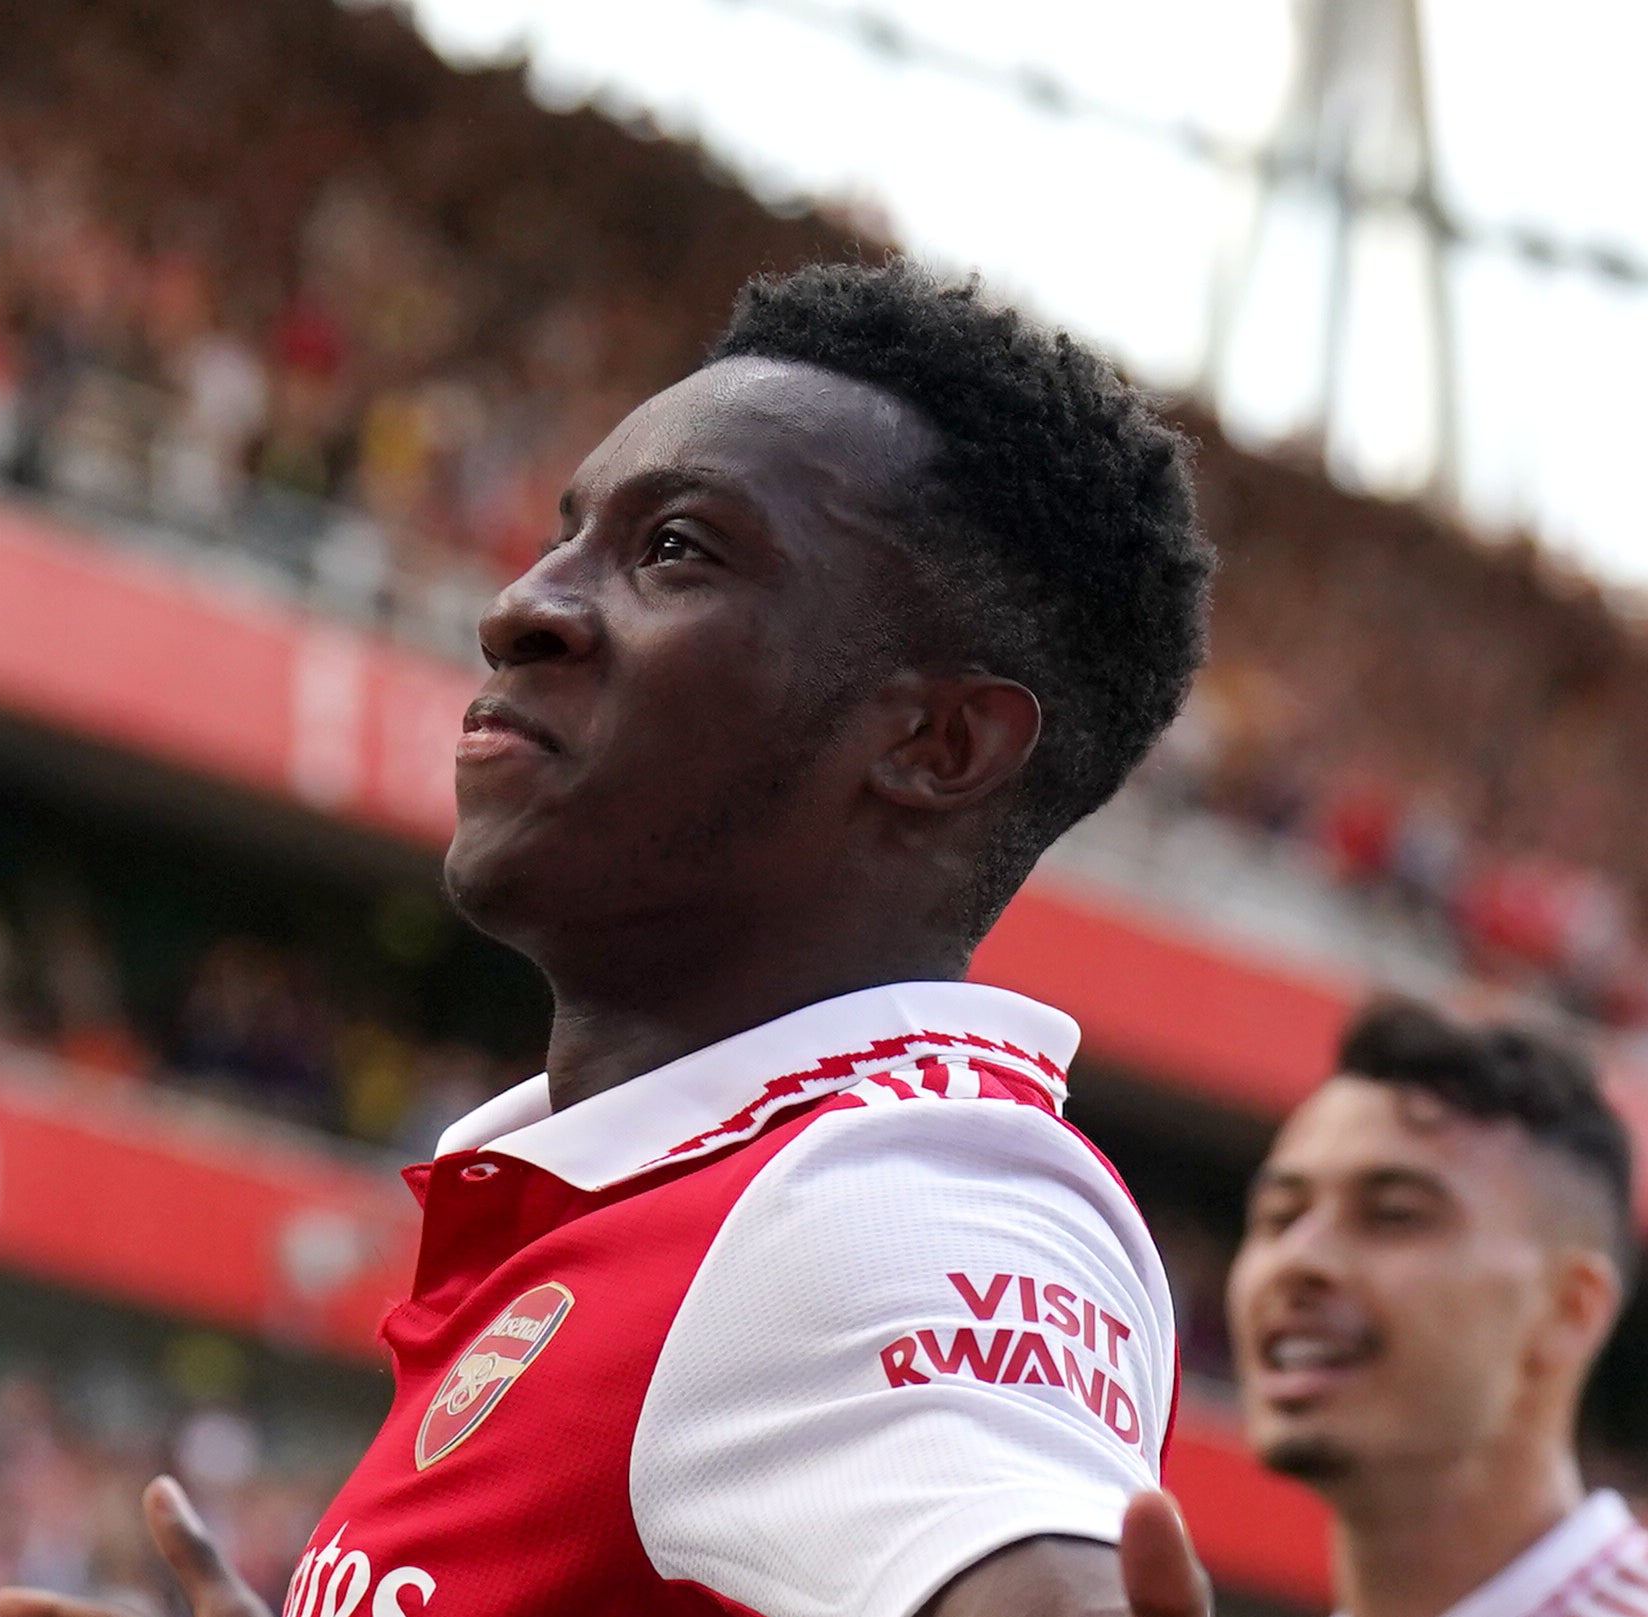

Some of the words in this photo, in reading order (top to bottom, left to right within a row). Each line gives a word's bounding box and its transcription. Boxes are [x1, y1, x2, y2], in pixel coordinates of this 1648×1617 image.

[486, 1311, 553, 1343] Arsenal
[946, 1272, 1131, 1370] VISIT
[879, 1328, 1145, 1457] RWAND
